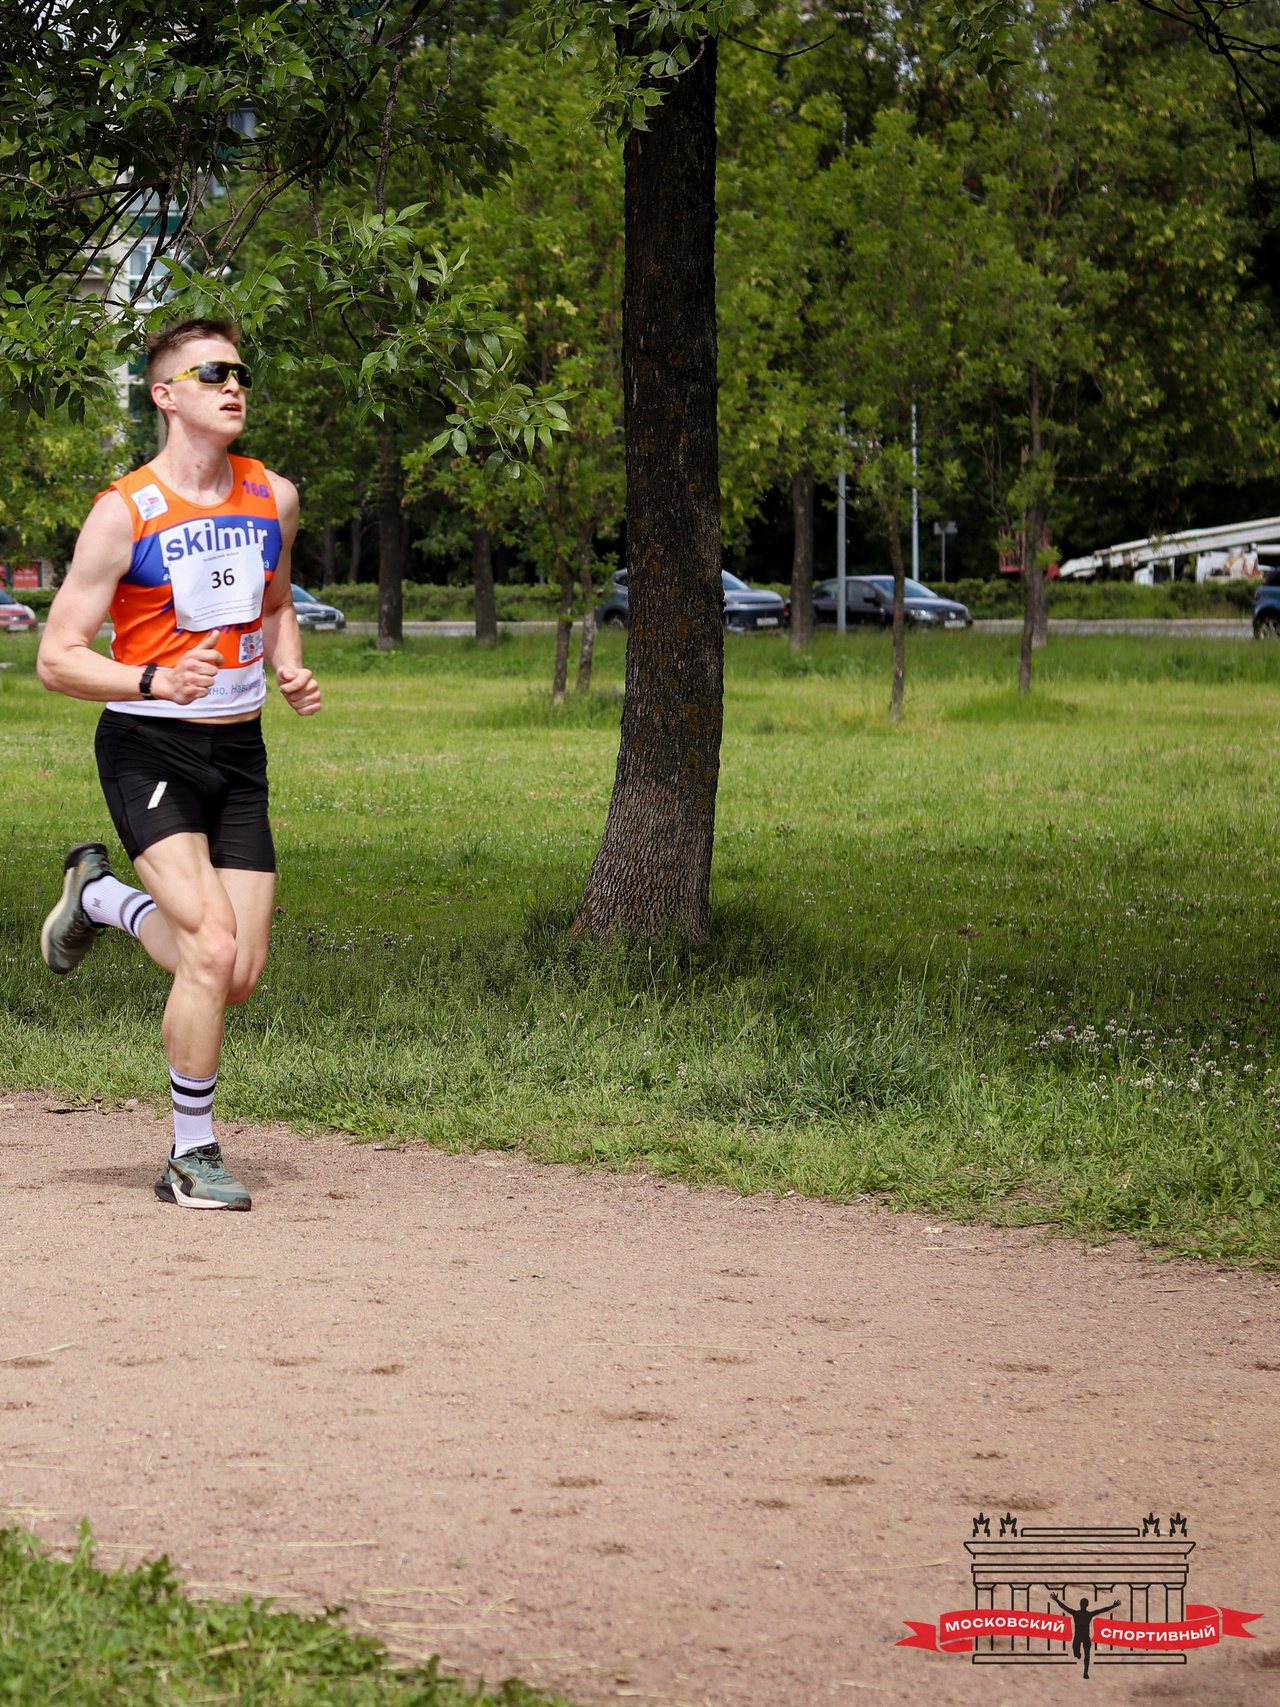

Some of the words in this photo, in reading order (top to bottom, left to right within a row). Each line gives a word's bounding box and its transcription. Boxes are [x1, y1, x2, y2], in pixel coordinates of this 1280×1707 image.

[241, 480, 270, 499] 168
[166, 520, 268, 562] skimir
[211, 568, 235, 589] 36
